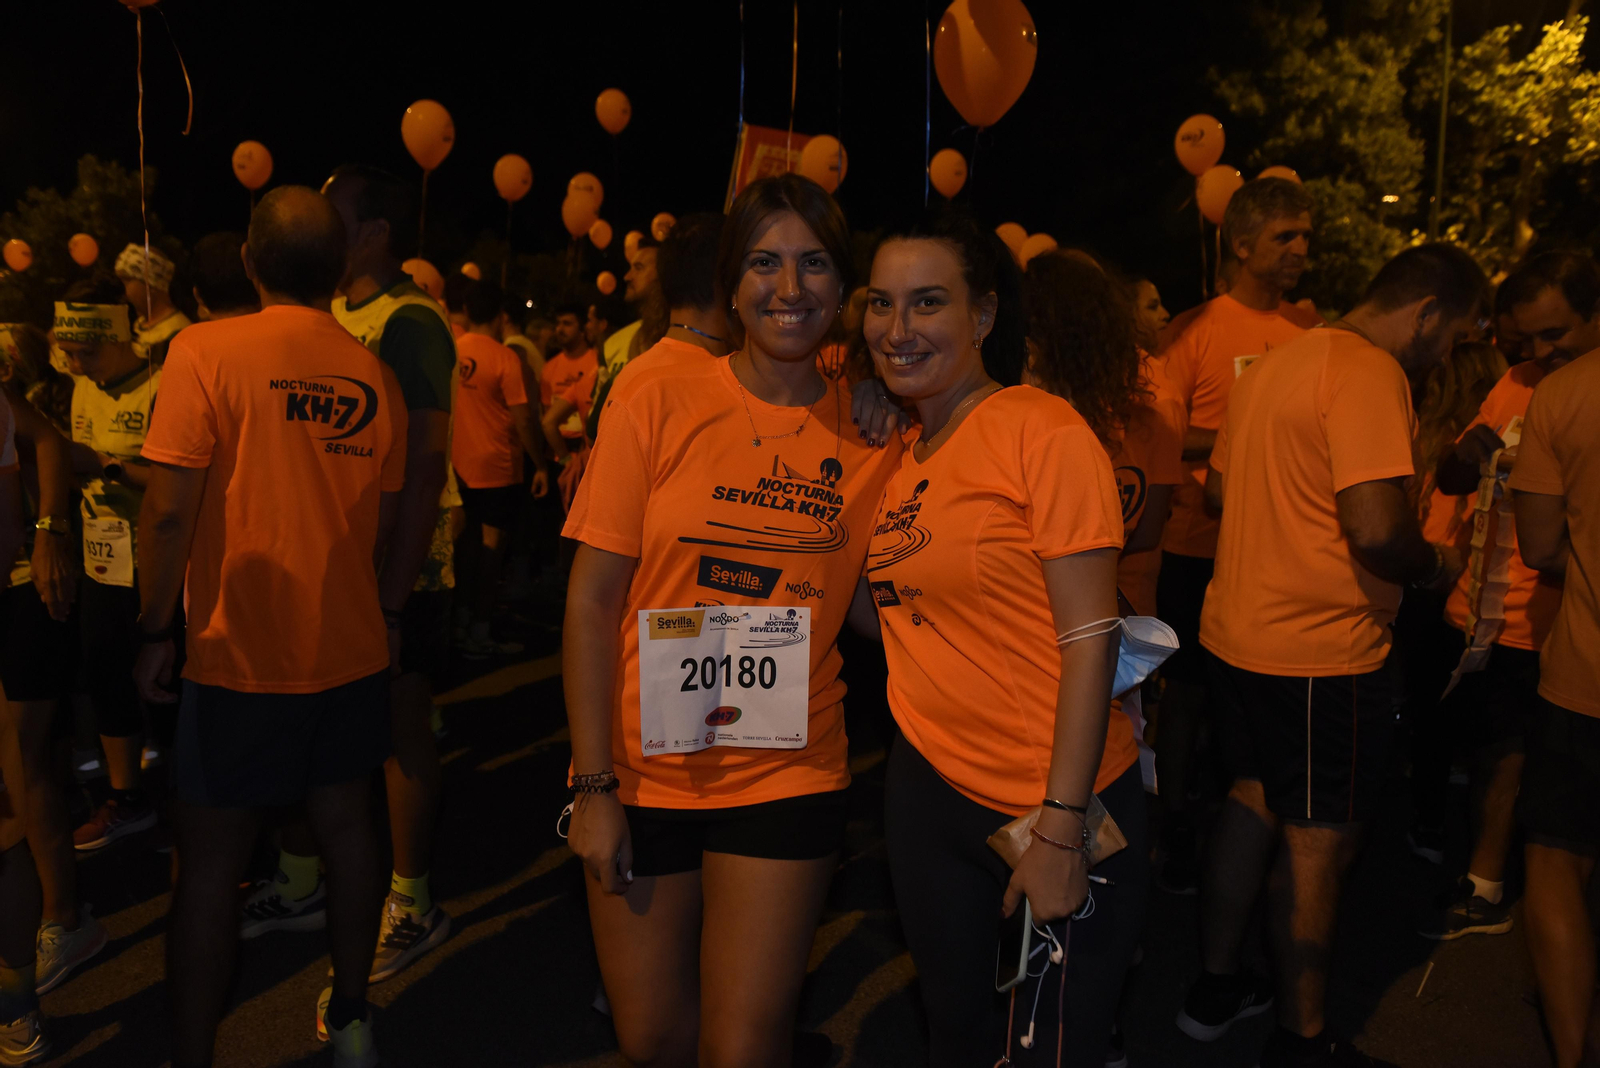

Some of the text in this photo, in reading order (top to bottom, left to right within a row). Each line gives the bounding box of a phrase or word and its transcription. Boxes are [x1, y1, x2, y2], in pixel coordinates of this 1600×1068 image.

[54, 316, 112, 329] UNNERS
[270, 380, 335, 395] NOCTURNA
[324, 443, 373, 457] SEVILLA
[712, 486, 796, 512] SEVILLA
[757, 477, 844, 506] NOCTURNA
[680, 654, 777, 692] 20180
[774, 735, 803, 743] Cruzcampo
